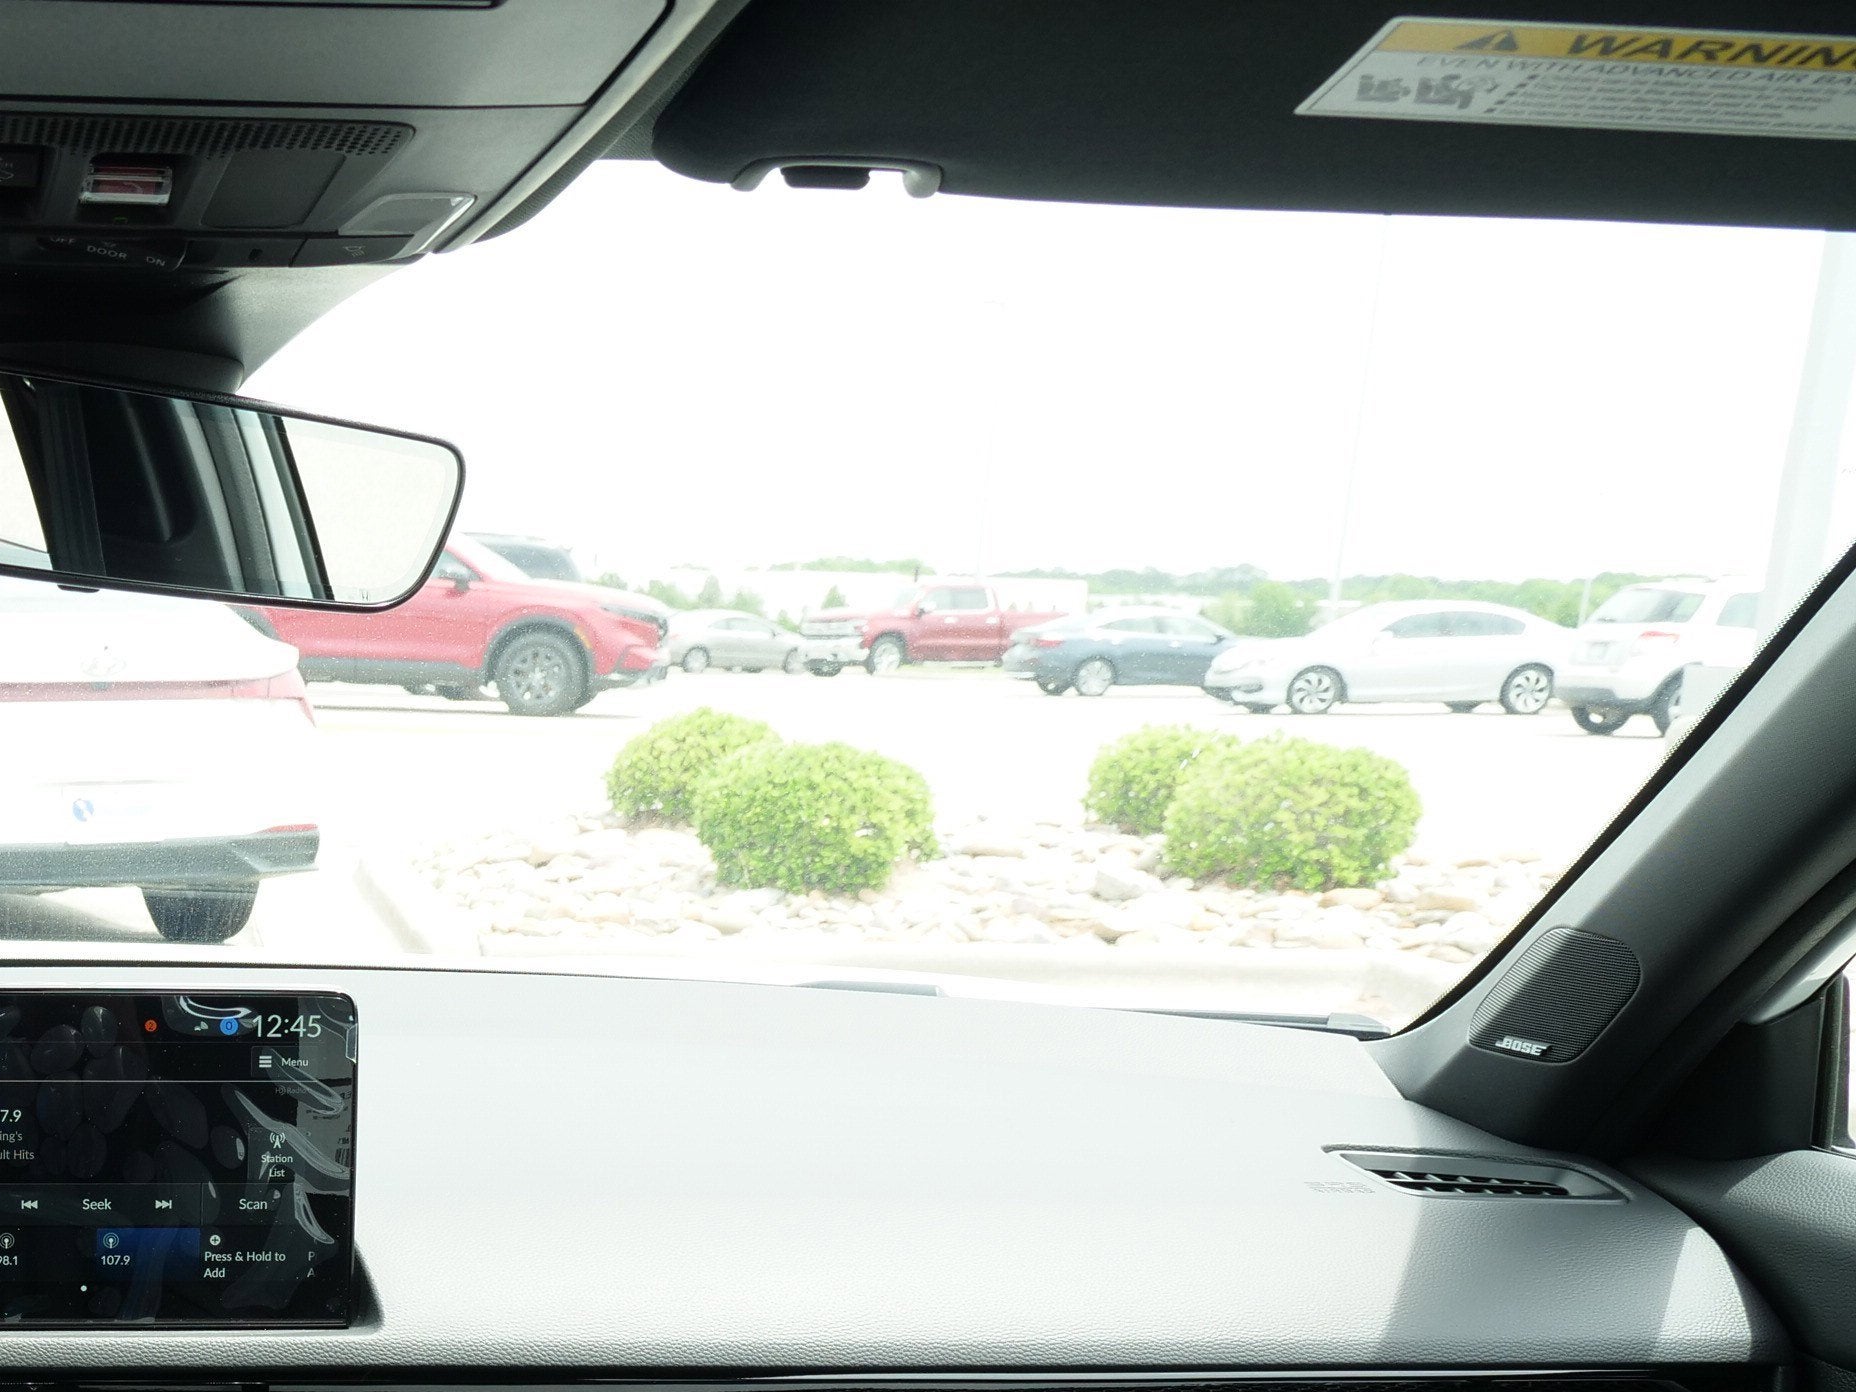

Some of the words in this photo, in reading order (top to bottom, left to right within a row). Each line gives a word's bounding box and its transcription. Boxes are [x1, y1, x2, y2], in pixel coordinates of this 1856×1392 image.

[1567, 33, 1856, 68] WARNIN
[86, 245, 128, 259] DOOR
[252, 1015, 322, 1038] 12:45
[1495, 1035, 1552, 1056] BOSE
[281, 1057, 309, 1067] Menu
[14, 1150, 35, 1160] Hits
[261, 1154, 294, 1163] Station
[269, 1168, 286, 1178] List
[82, 1199, 112, 1210] Seek
[238, 1199, 268, 1210] Scan
[100, 1256, 131, 1266] 107.9
[204, 1252, 232, 1262] Press
[235, 1252, 244, 1262] &
[246, 1252, 272, 1262] Hold
[274, 1252, 286, 1262] to
[204, 1268, 226, 1278] Add
